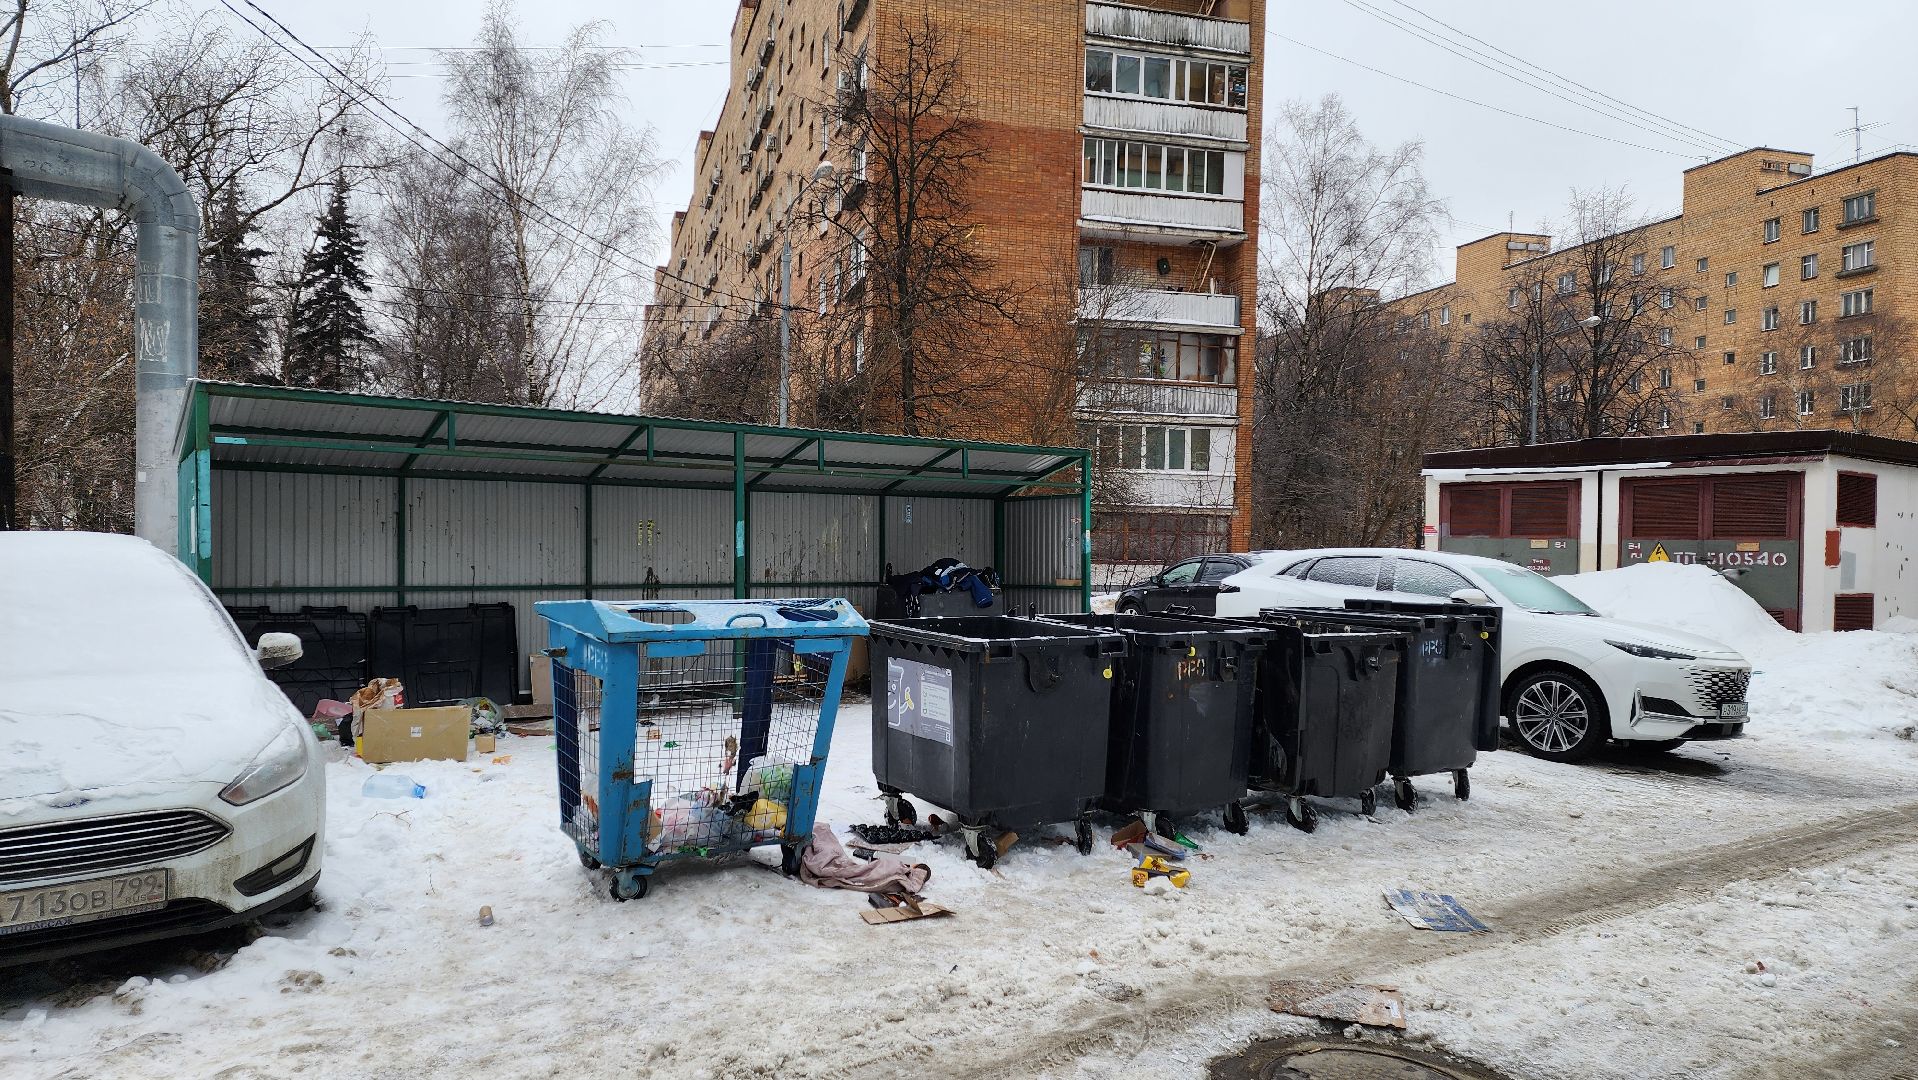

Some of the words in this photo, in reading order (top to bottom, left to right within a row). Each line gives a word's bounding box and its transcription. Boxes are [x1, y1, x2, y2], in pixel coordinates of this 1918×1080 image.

[1706, 551, 1788, 566] 510540
[0, 889, 107, 922] 713ОВ
[114, 875, 158, 899] 799
[125, 894, 147, 904] RUS
